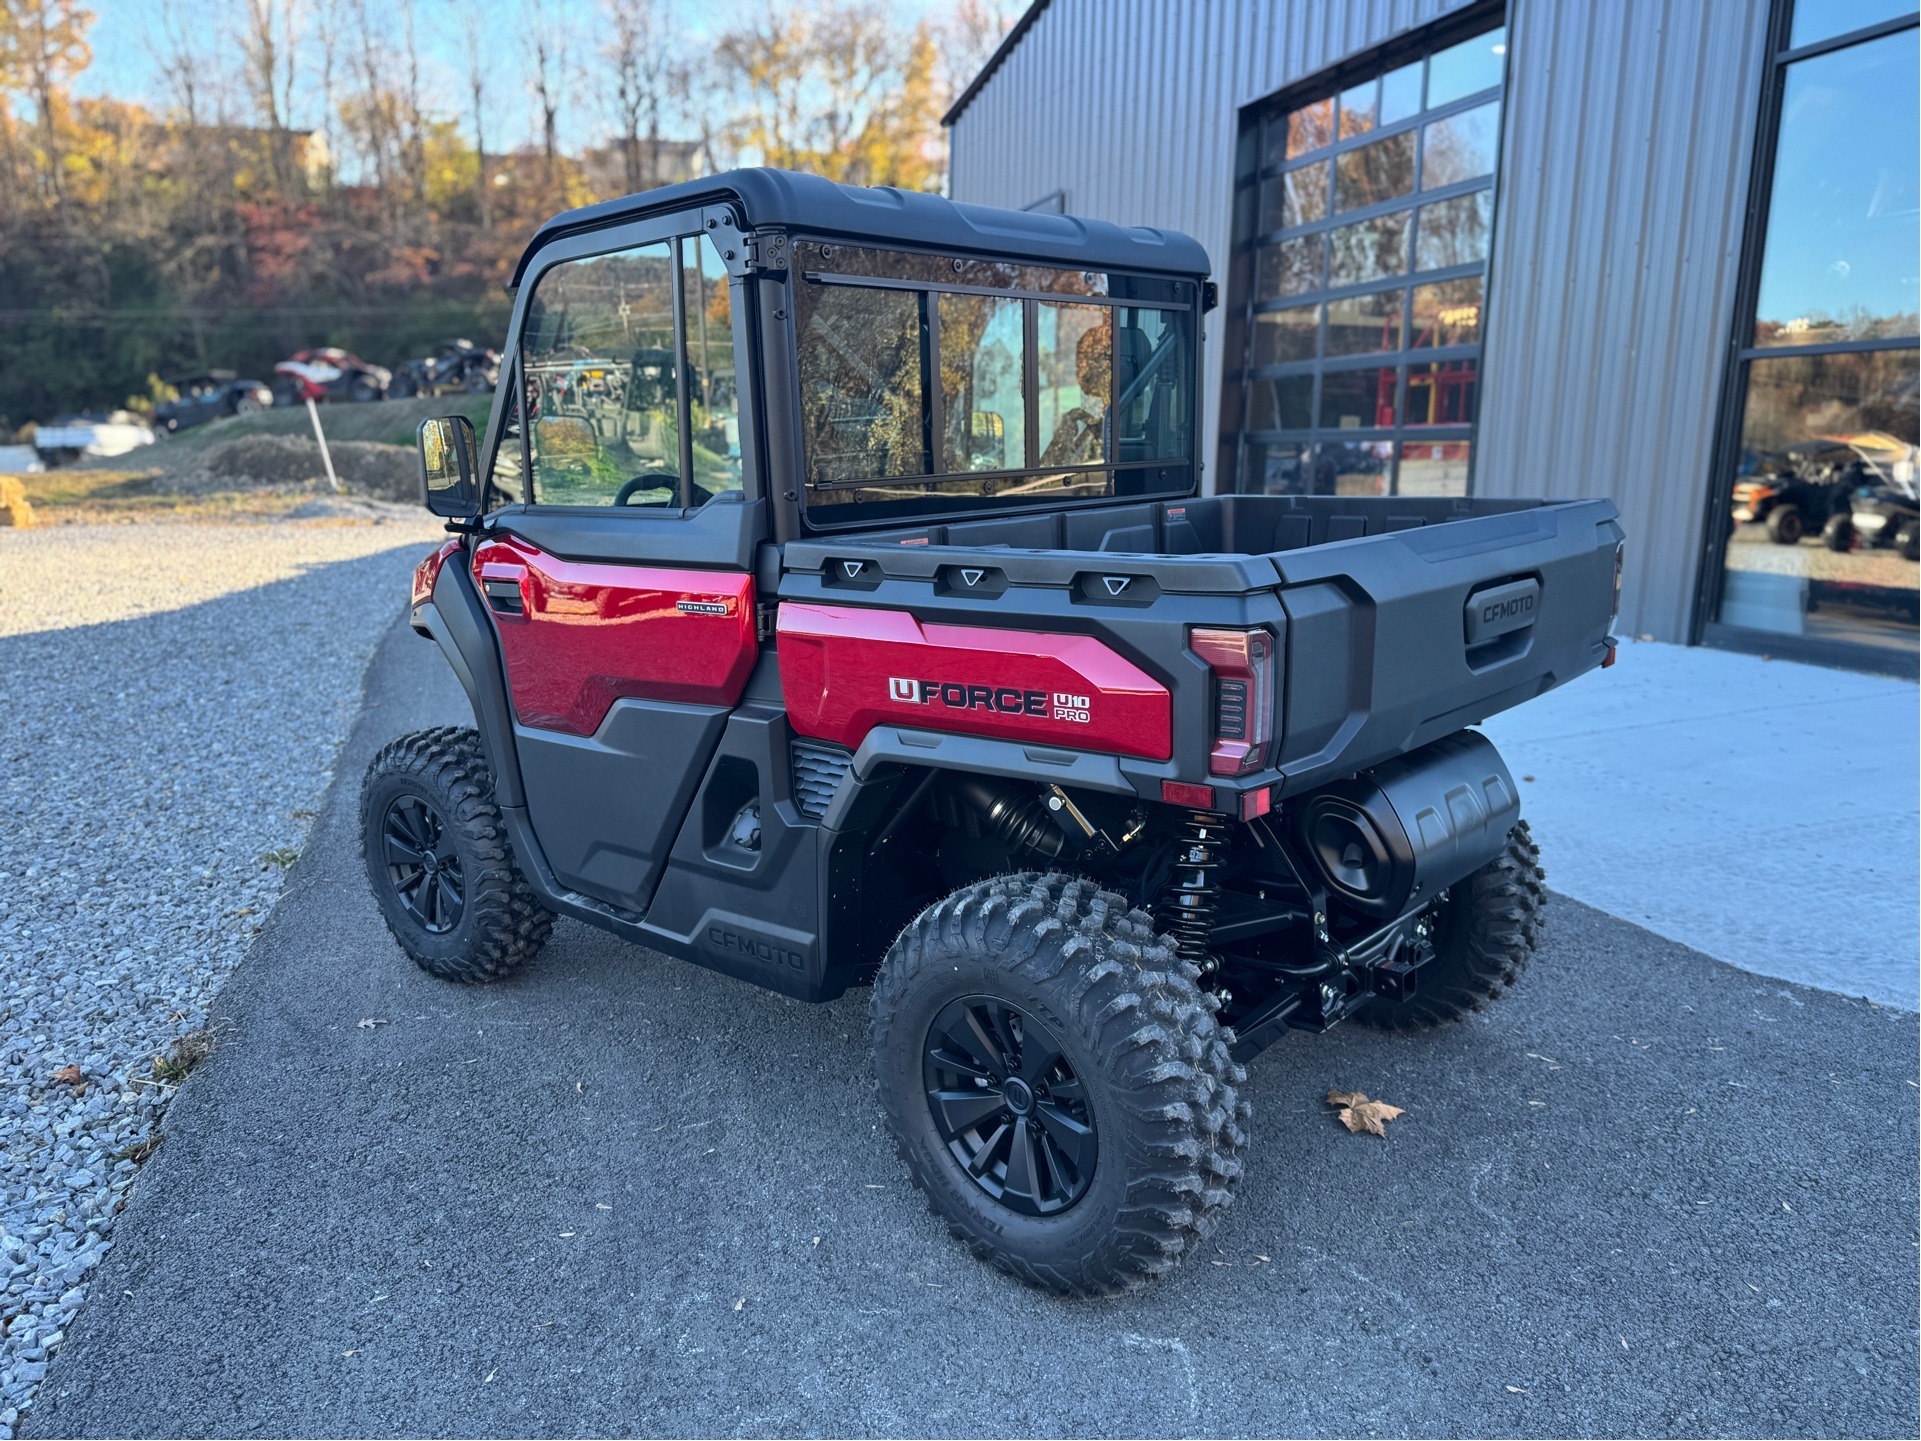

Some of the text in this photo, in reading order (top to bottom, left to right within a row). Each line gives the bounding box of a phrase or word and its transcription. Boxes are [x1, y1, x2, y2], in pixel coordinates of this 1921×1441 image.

[678, 604, 724, 612] HIGHLAND
[1483, 594, 1534, 624] CFMOTO
[1054, 708, 1090, 723] PRO
[708, 927, 805, 973] CFMOTO
[1027, 995, 1065, 1031] ITP
